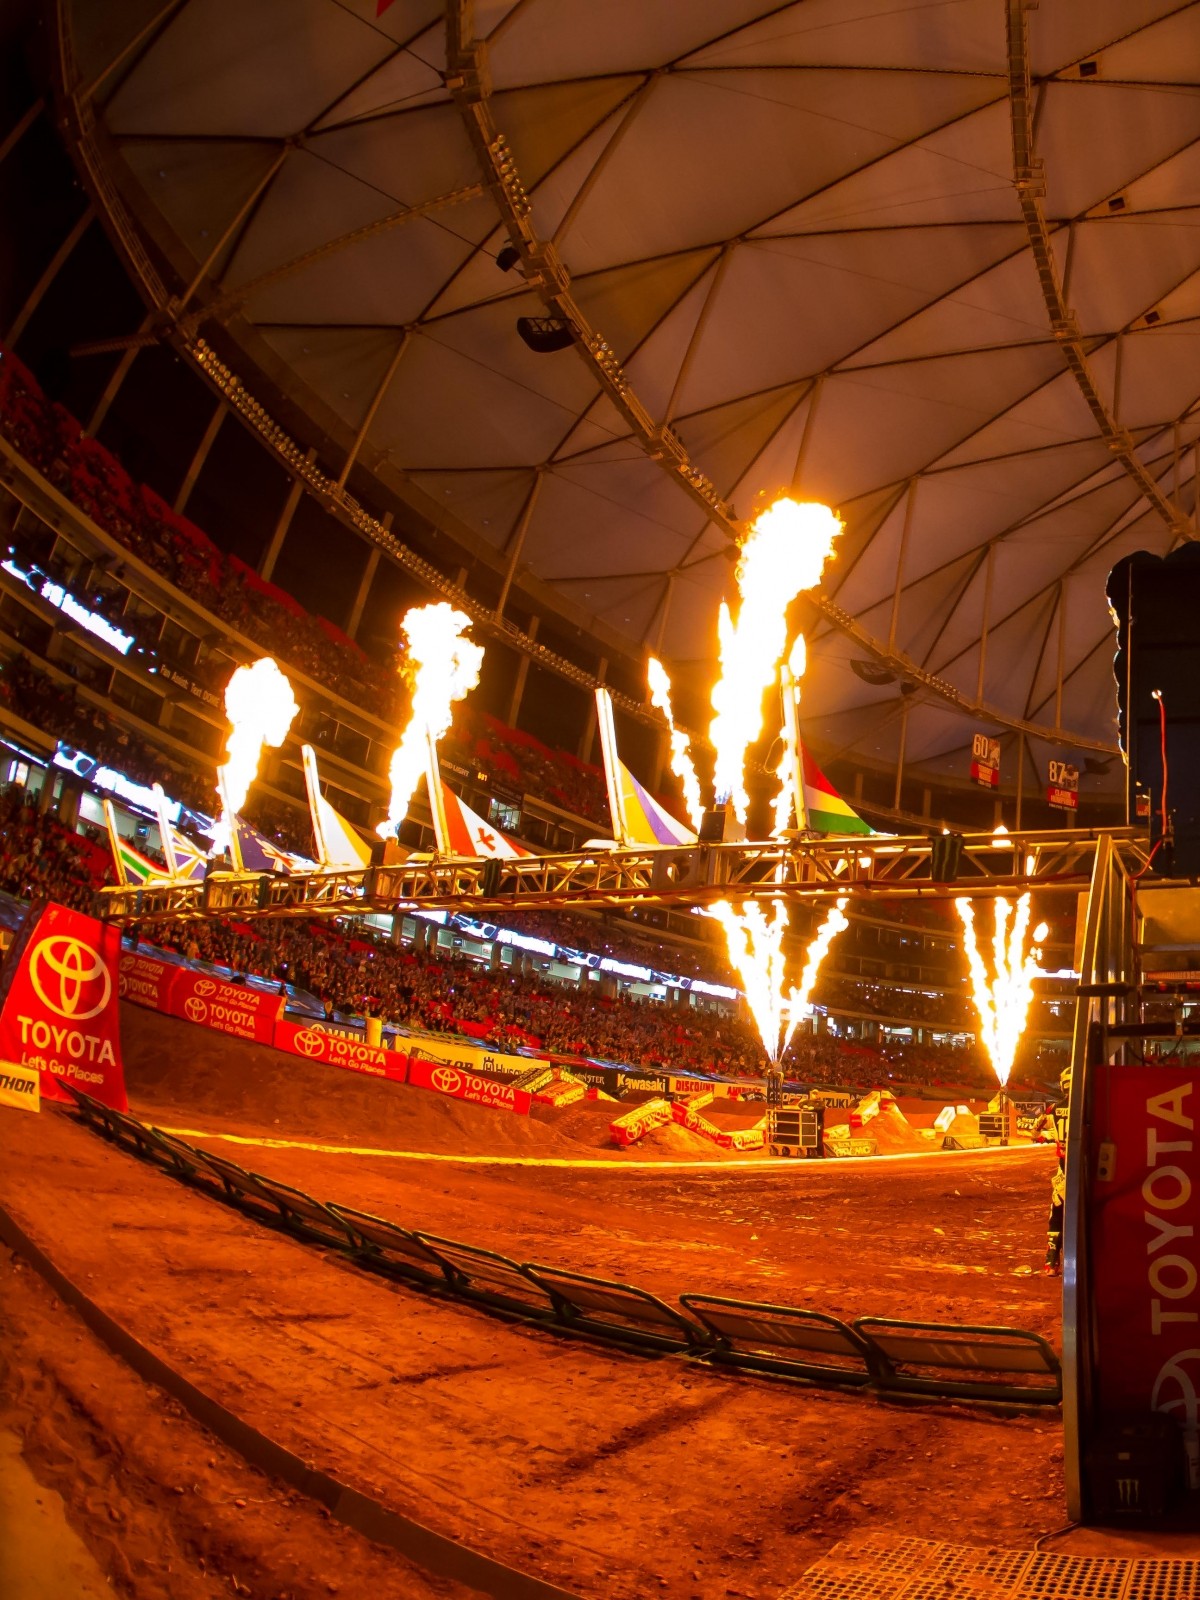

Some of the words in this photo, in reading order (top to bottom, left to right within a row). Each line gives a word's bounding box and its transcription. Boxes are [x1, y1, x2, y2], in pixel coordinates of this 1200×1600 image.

[973, 734, 989, 759] 60
[1050, 761, 1065, 784] 87
[127, 977, 158, 998] TOYOTA
[219, 985, 260, 1005] TOYOTA
[209, 1003, 256, 1030] TOYOTA
[17, 1015, 117, 1066] TOYOTA
[328, 1038, 387, 1066] TOYOTA
[21, 1052, 47, 1071] Let's
[49, 1060, 65, 1075] Go
[67, 1065, 104, 1085] Places
[328, 1054, 347, 1066] Let's
[347, 1059, 360, 1070] Go
[360, 1062, 386, 1077] Places
[464, 1075, 515, 1102] TOYOTA
[617, 1073, 666, 1093] Kawasaki
[464, 1089, 481, 1101] Let's
[482, 1095, 492, 1104] Go
[493, 1098, 514, 1110] Places
[1142, 1082, 1199, 1335] TOYOTA
